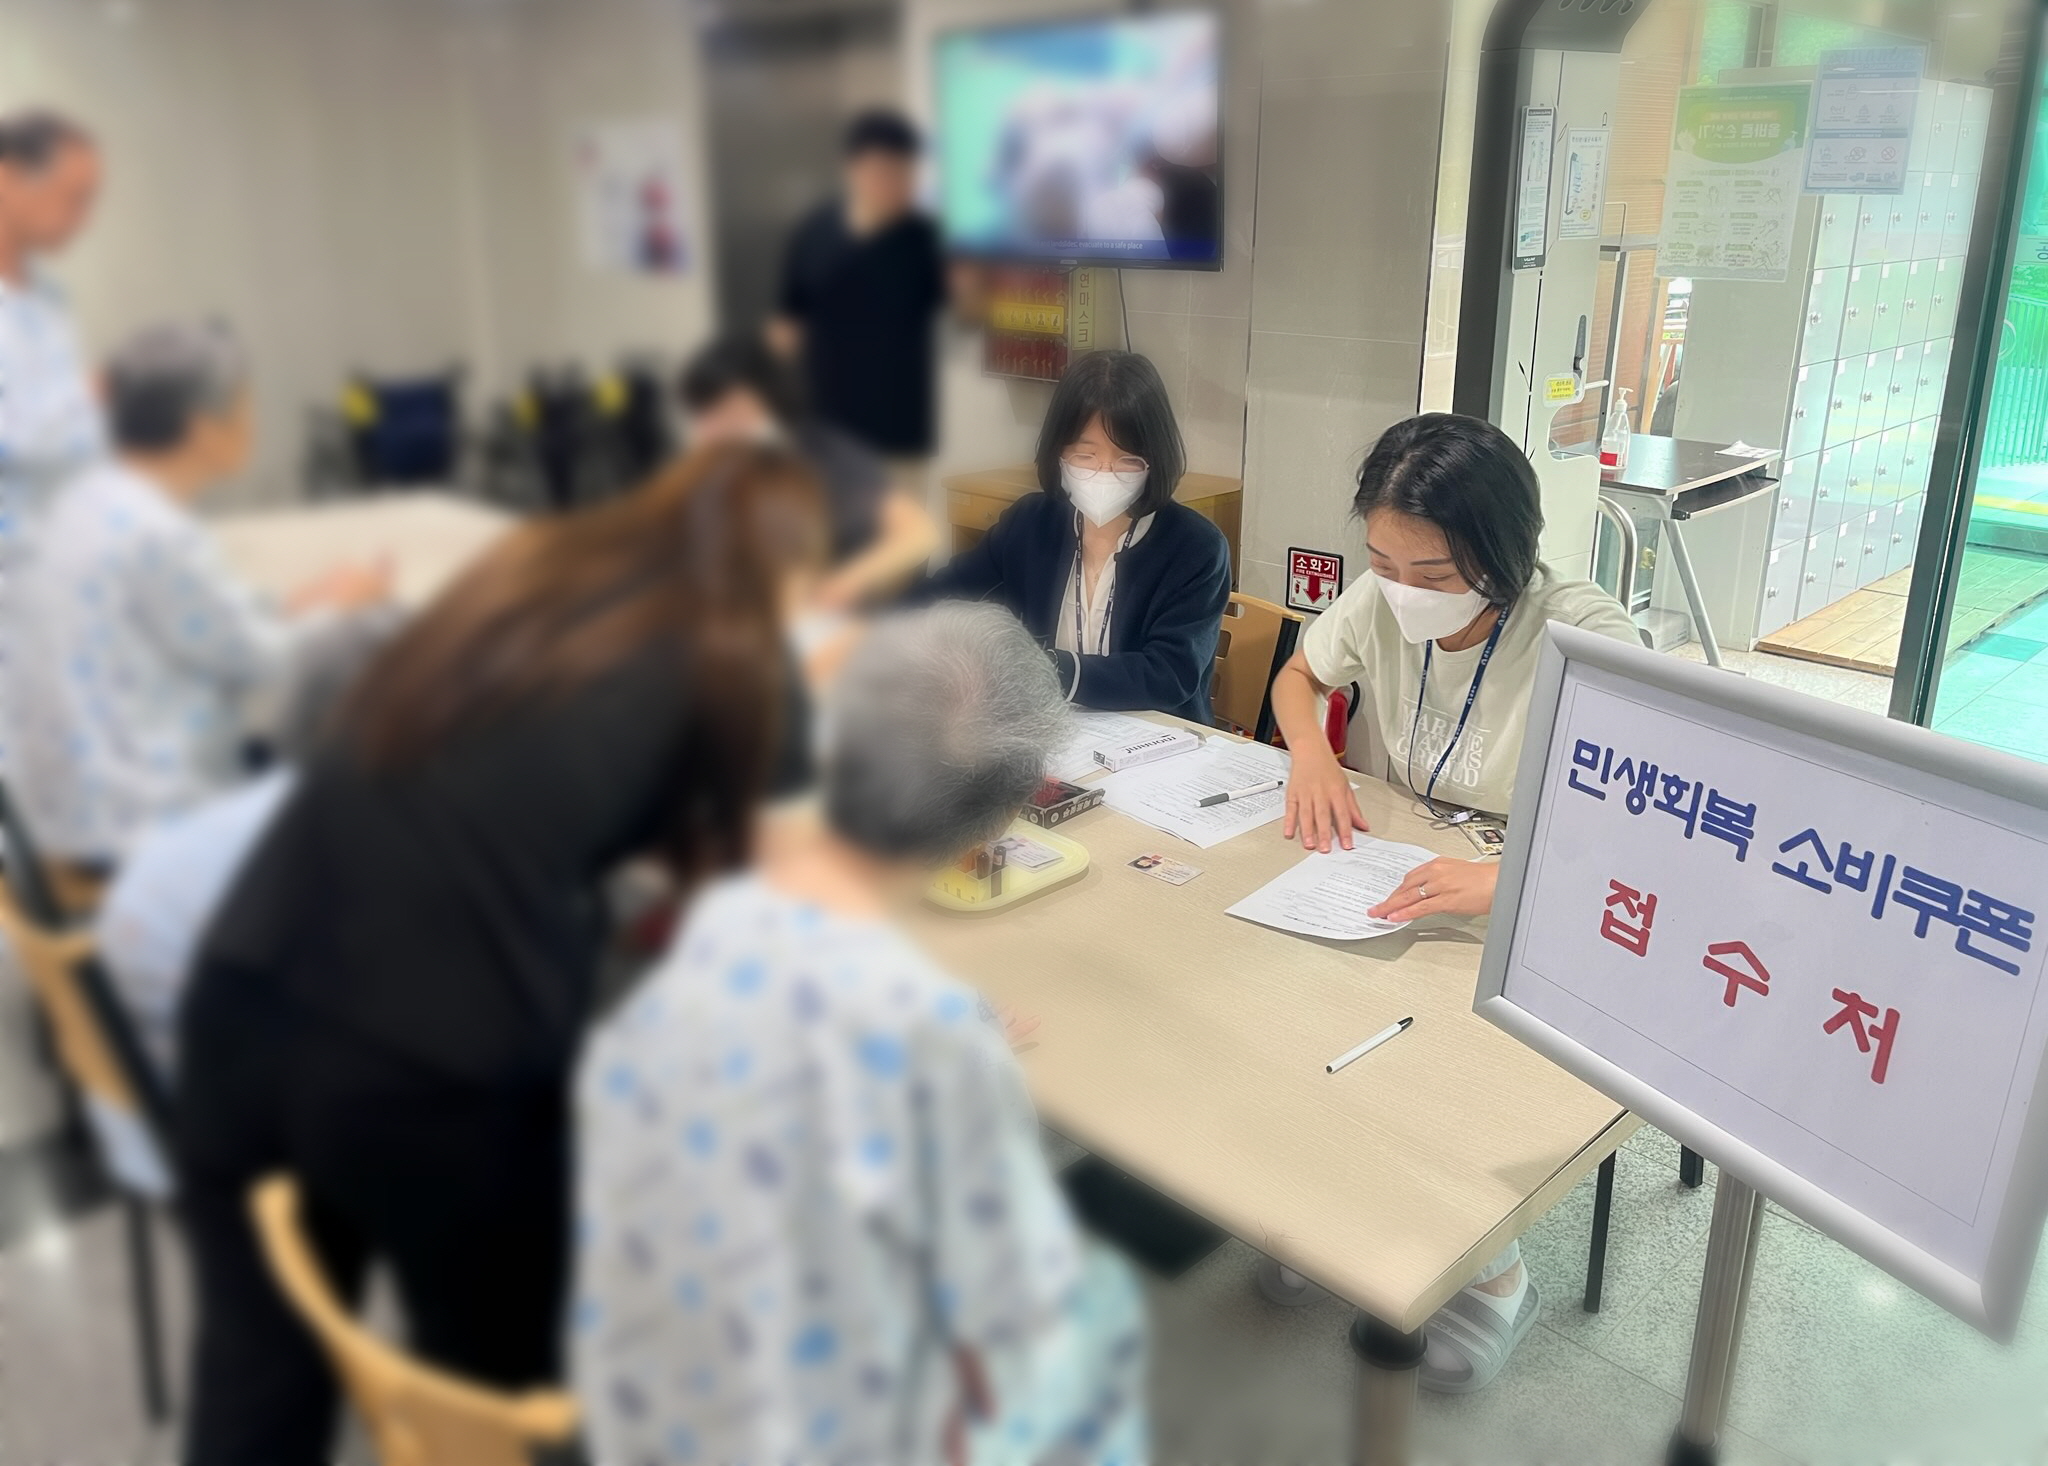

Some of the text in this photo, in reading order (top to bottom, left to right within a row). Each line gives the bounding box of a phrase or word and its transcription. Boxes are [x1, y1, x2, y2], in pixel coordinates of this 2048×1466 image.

[1079, 241, 1103, 249] evacuate
[1103, 241, 1110, 249] to
[1114, 241, 1127, 249] safe
[1127, 242, 1143, 251] place
[1295, 556, 1335, 575] 소화기
[1567, 738, 2036, 977] 민생회복 소비쿠폰
[1600, 879, 1901, 1084] 접 수 처
